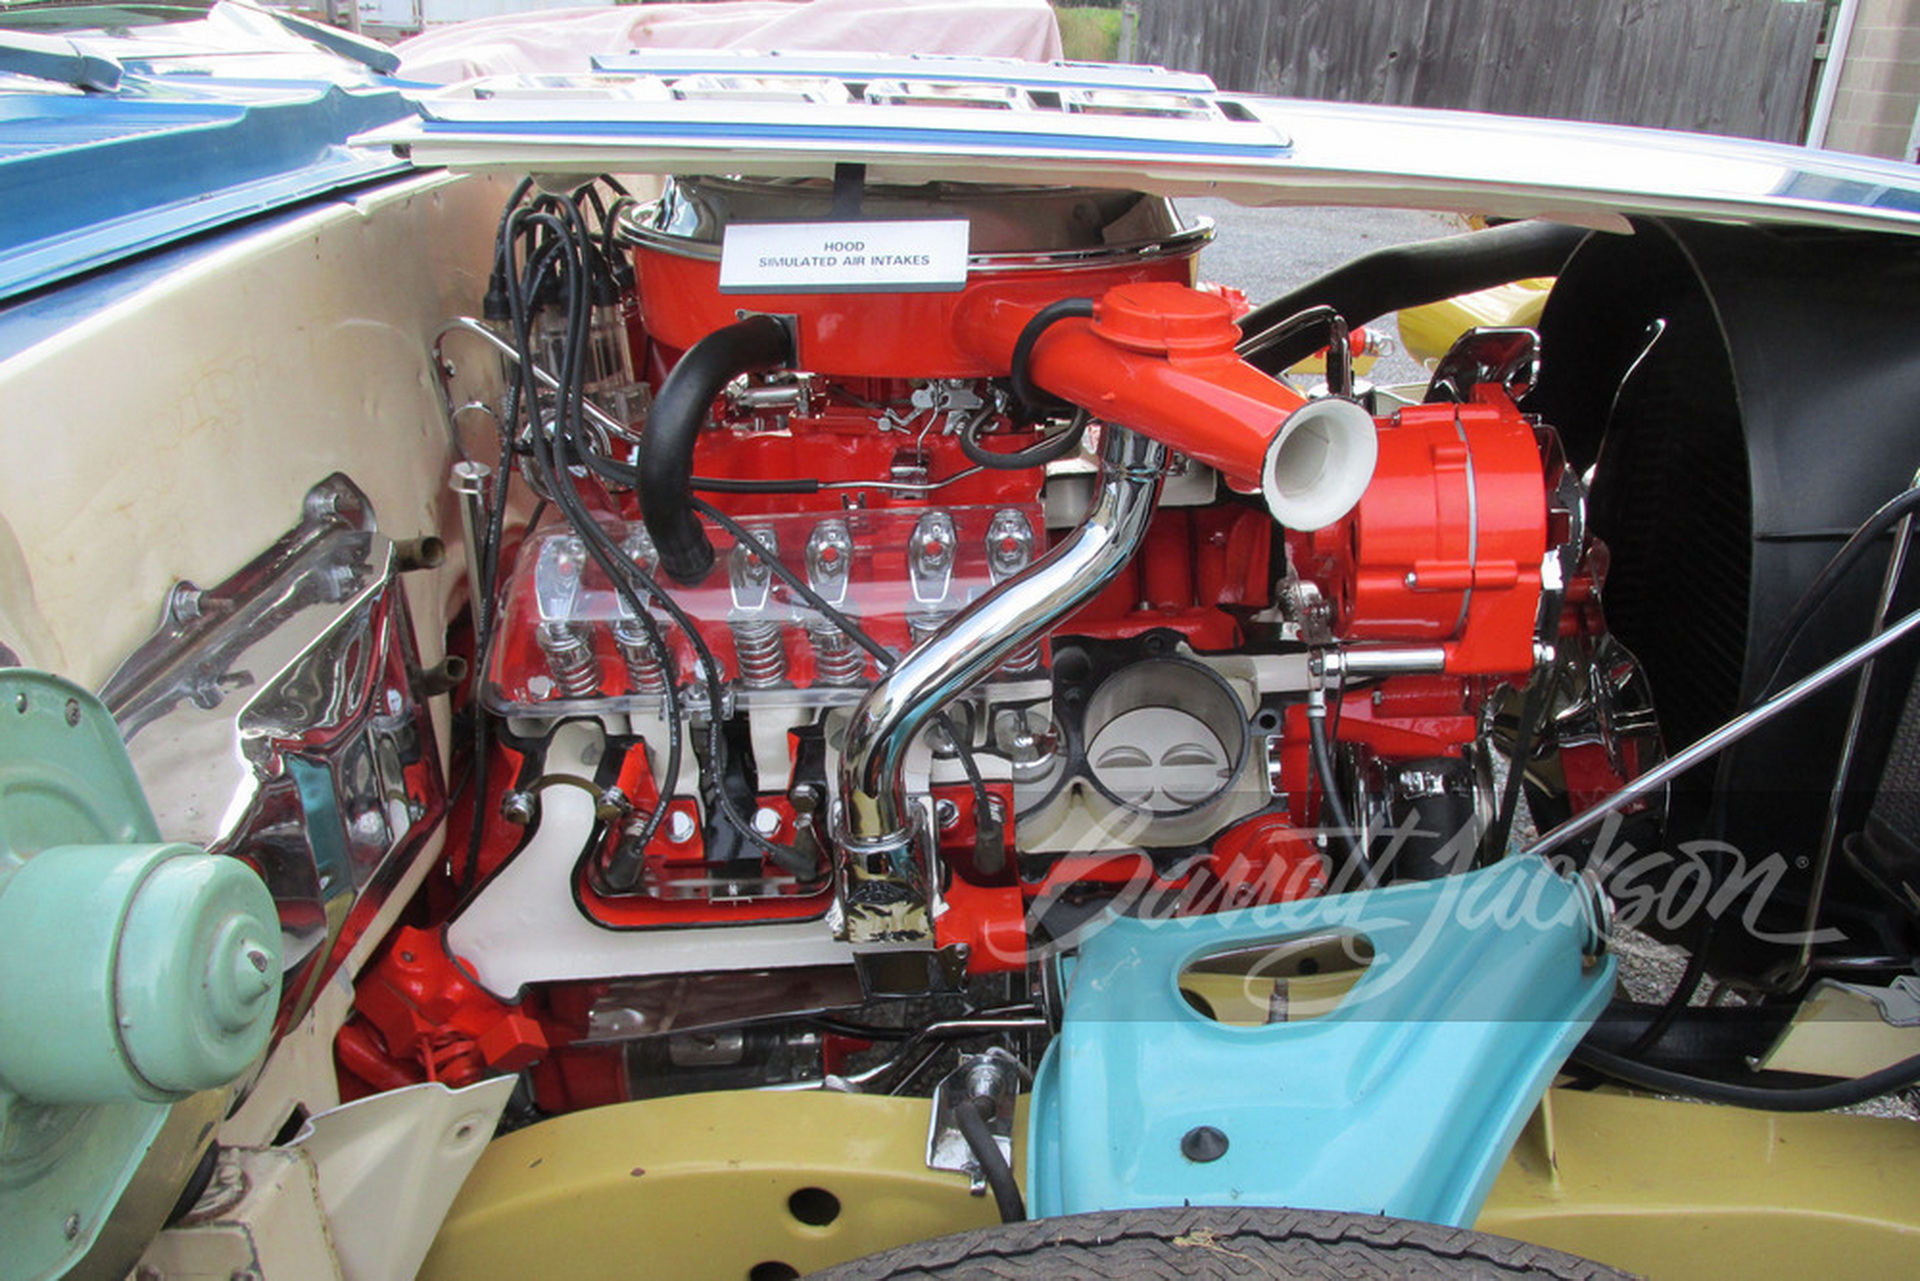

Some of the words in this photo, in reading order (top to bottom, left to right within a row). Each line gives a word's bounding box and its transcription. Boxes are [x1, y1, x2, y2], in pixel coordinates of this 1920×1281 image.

[823, 241, 866, 252] HOOD
[759, 255, 838, 268] SIMULATED
[842, 255, 866, 266] AIR
[870, 254, 931, 266] INTAKES
